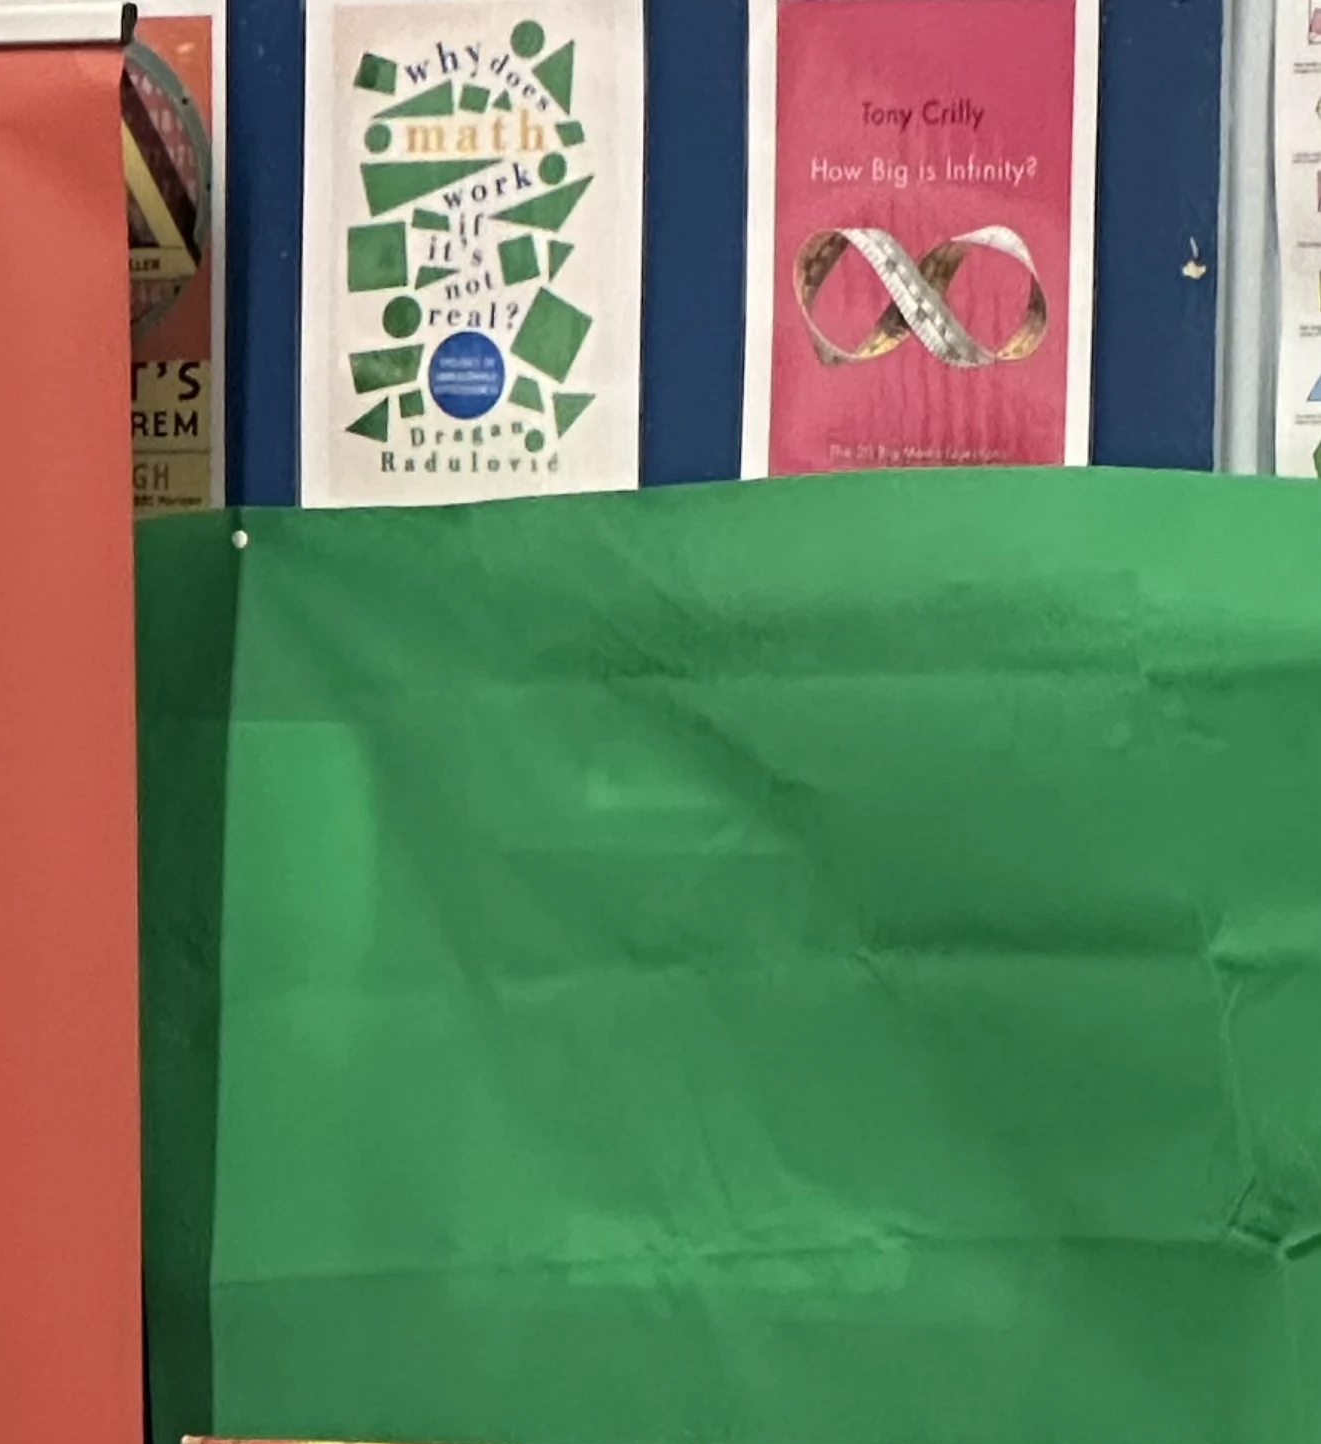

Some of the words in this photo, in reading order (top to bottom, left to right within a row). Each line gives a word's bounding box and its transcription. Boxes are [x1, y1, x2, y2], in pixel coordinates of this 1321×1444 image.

[405, 41, 481, 84] why
[490, 54, 549, 112] does
[406, 109, 546, 153] math
[862, 101, 912, 134] Tony
[922, 98, 984, 131] Crilly
[443, 162, 532, 209] work
[811, 156, 862, 183] How
[872, 156, 908, 189] Big
[919, 159, 936, 182] is
[945, 153, 1038, 188] Infinity?
[459, 211, 485, 237] if
[429, 234, 483, 267] it's
[445, 270, 494, 300] not
[429, 302, 519, 330] real?
[132, 411, 198, 437] REM
[410, 421, 524, 447] Dragan
